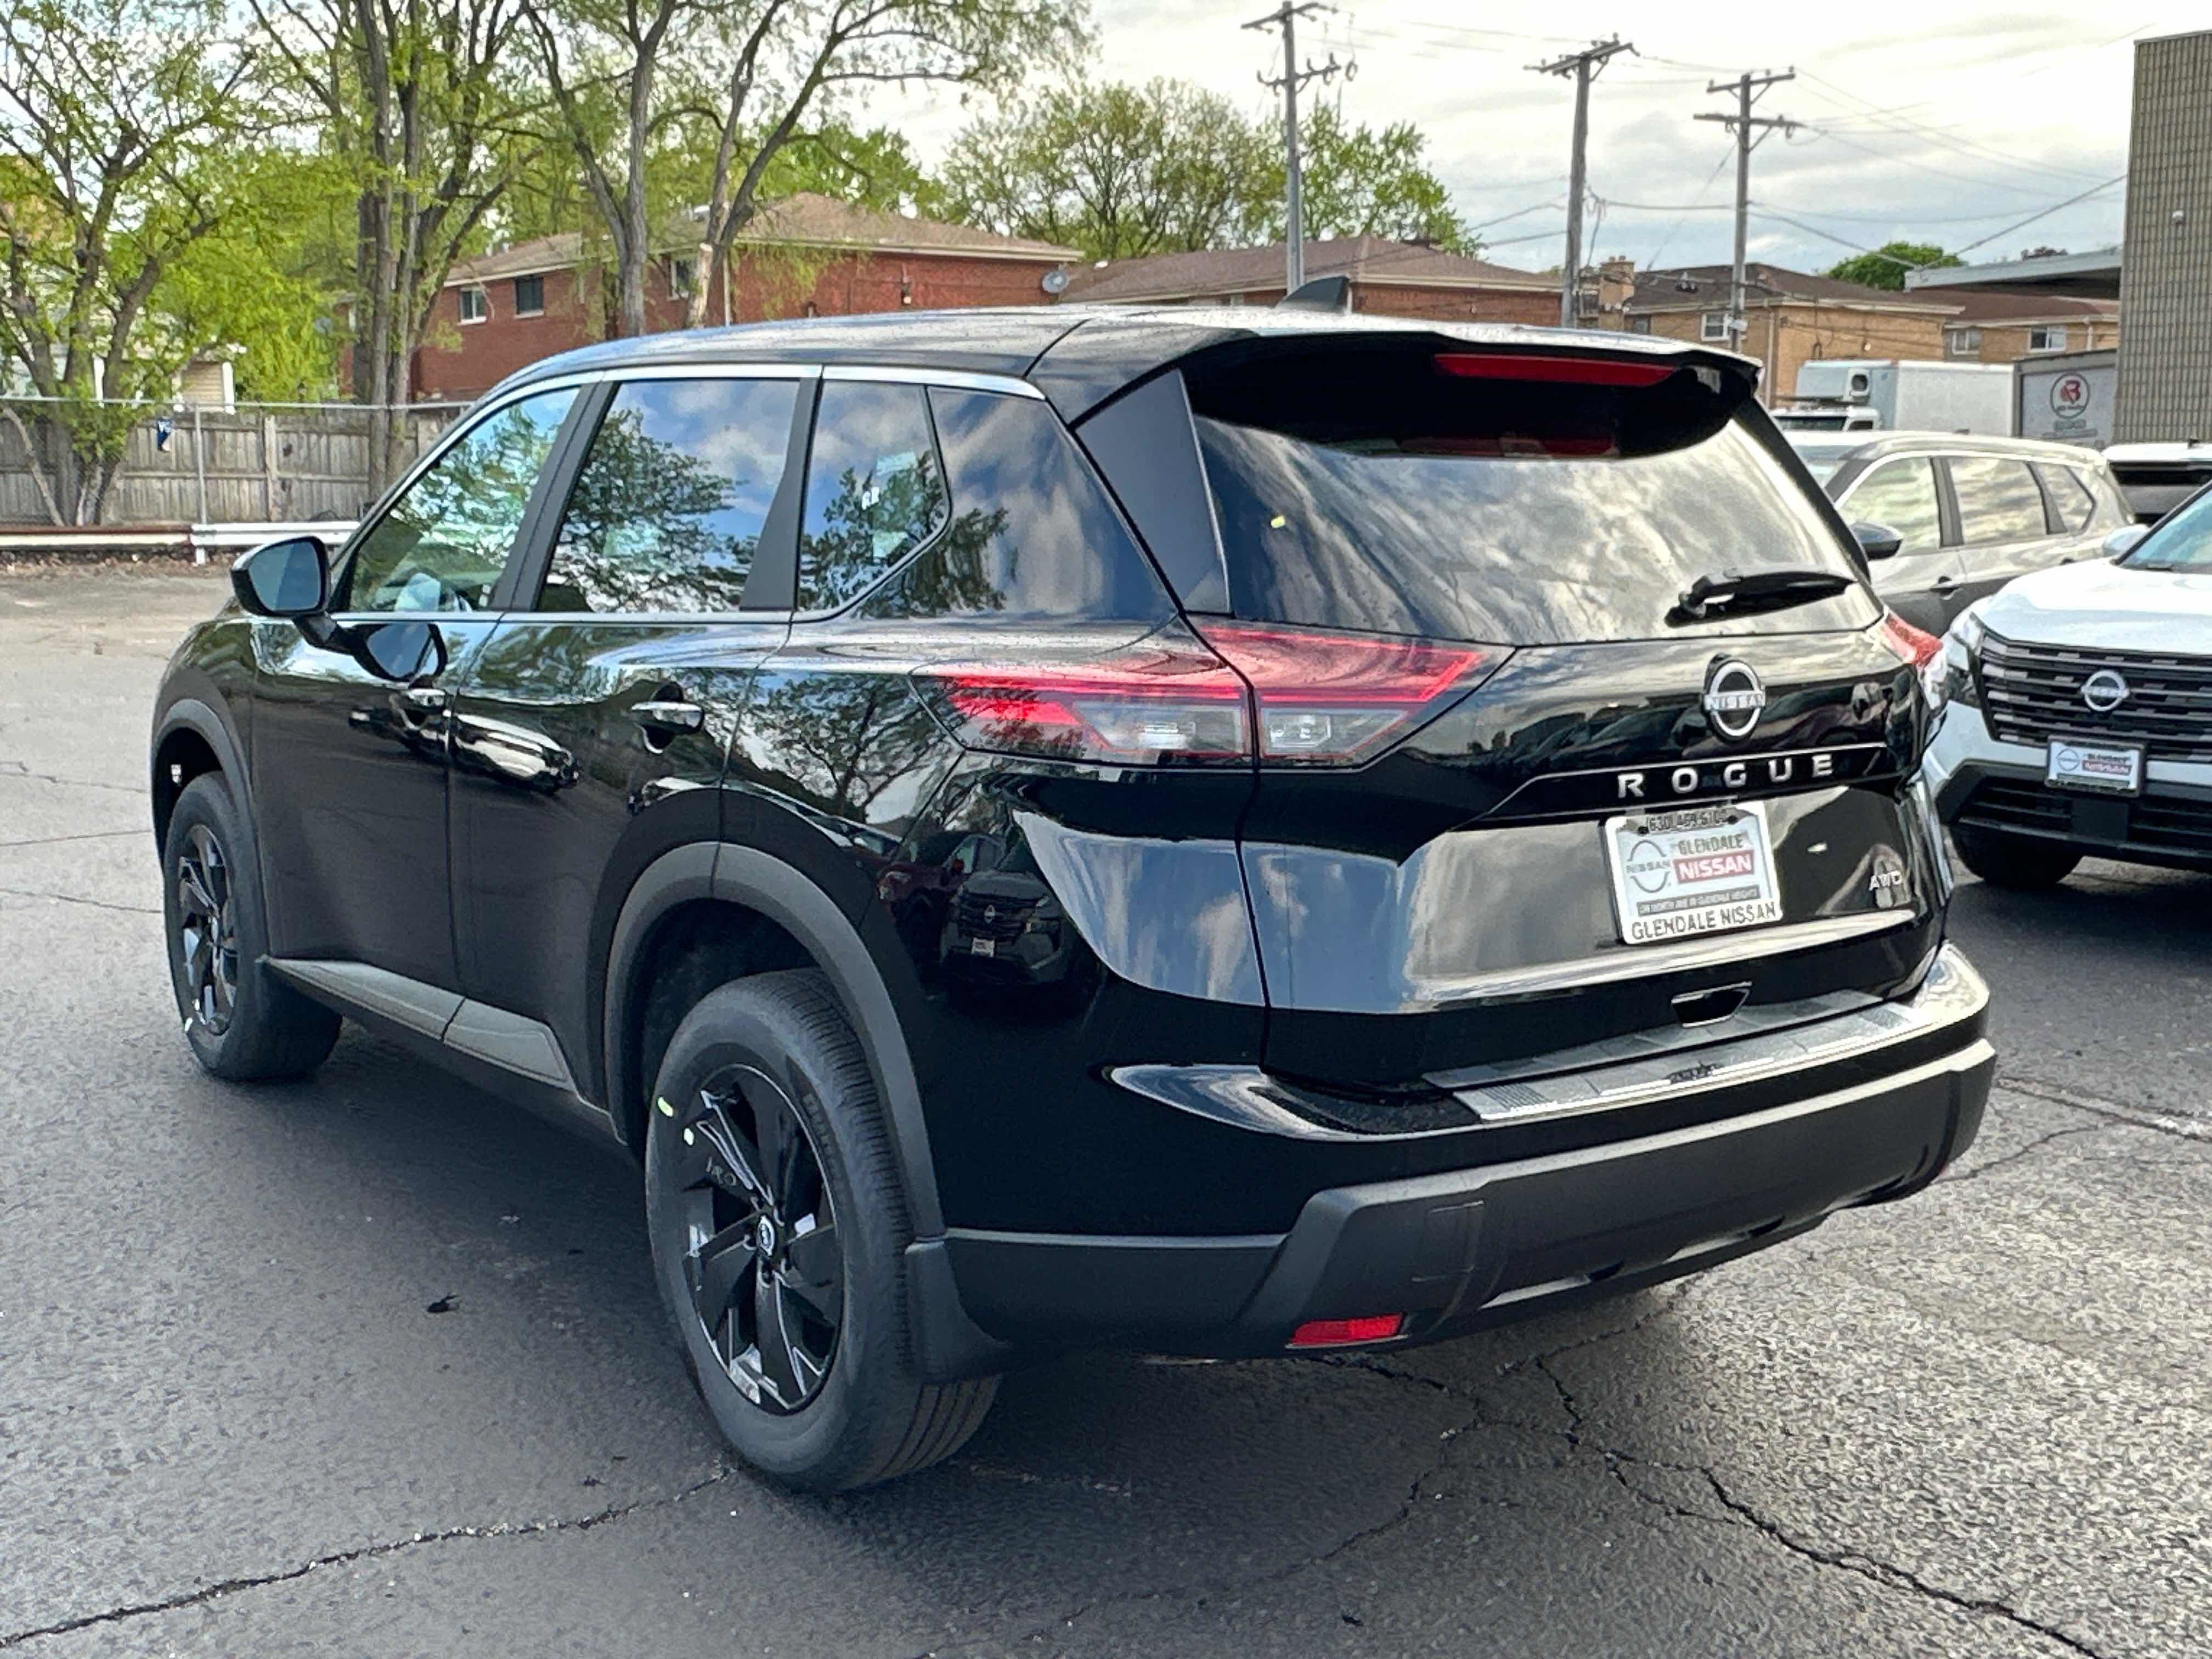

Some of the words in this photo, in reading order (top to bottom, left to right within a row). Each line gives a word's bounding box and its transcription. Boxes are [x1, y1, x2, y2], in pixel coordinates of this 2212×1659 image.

[1617, 753, 1833, 799] ROGUE
[1677, 833, 1743, 855] GLENDALE
[1626, 860, 1671, 873] NISSAN
[1678, 854, 1752, 880] NISSAN
[1869, 871, 1902, 891] AWD
[1632, 910, 1717, 940] GLENDALE
[1720, 901, 1776, 926] NISSAN
